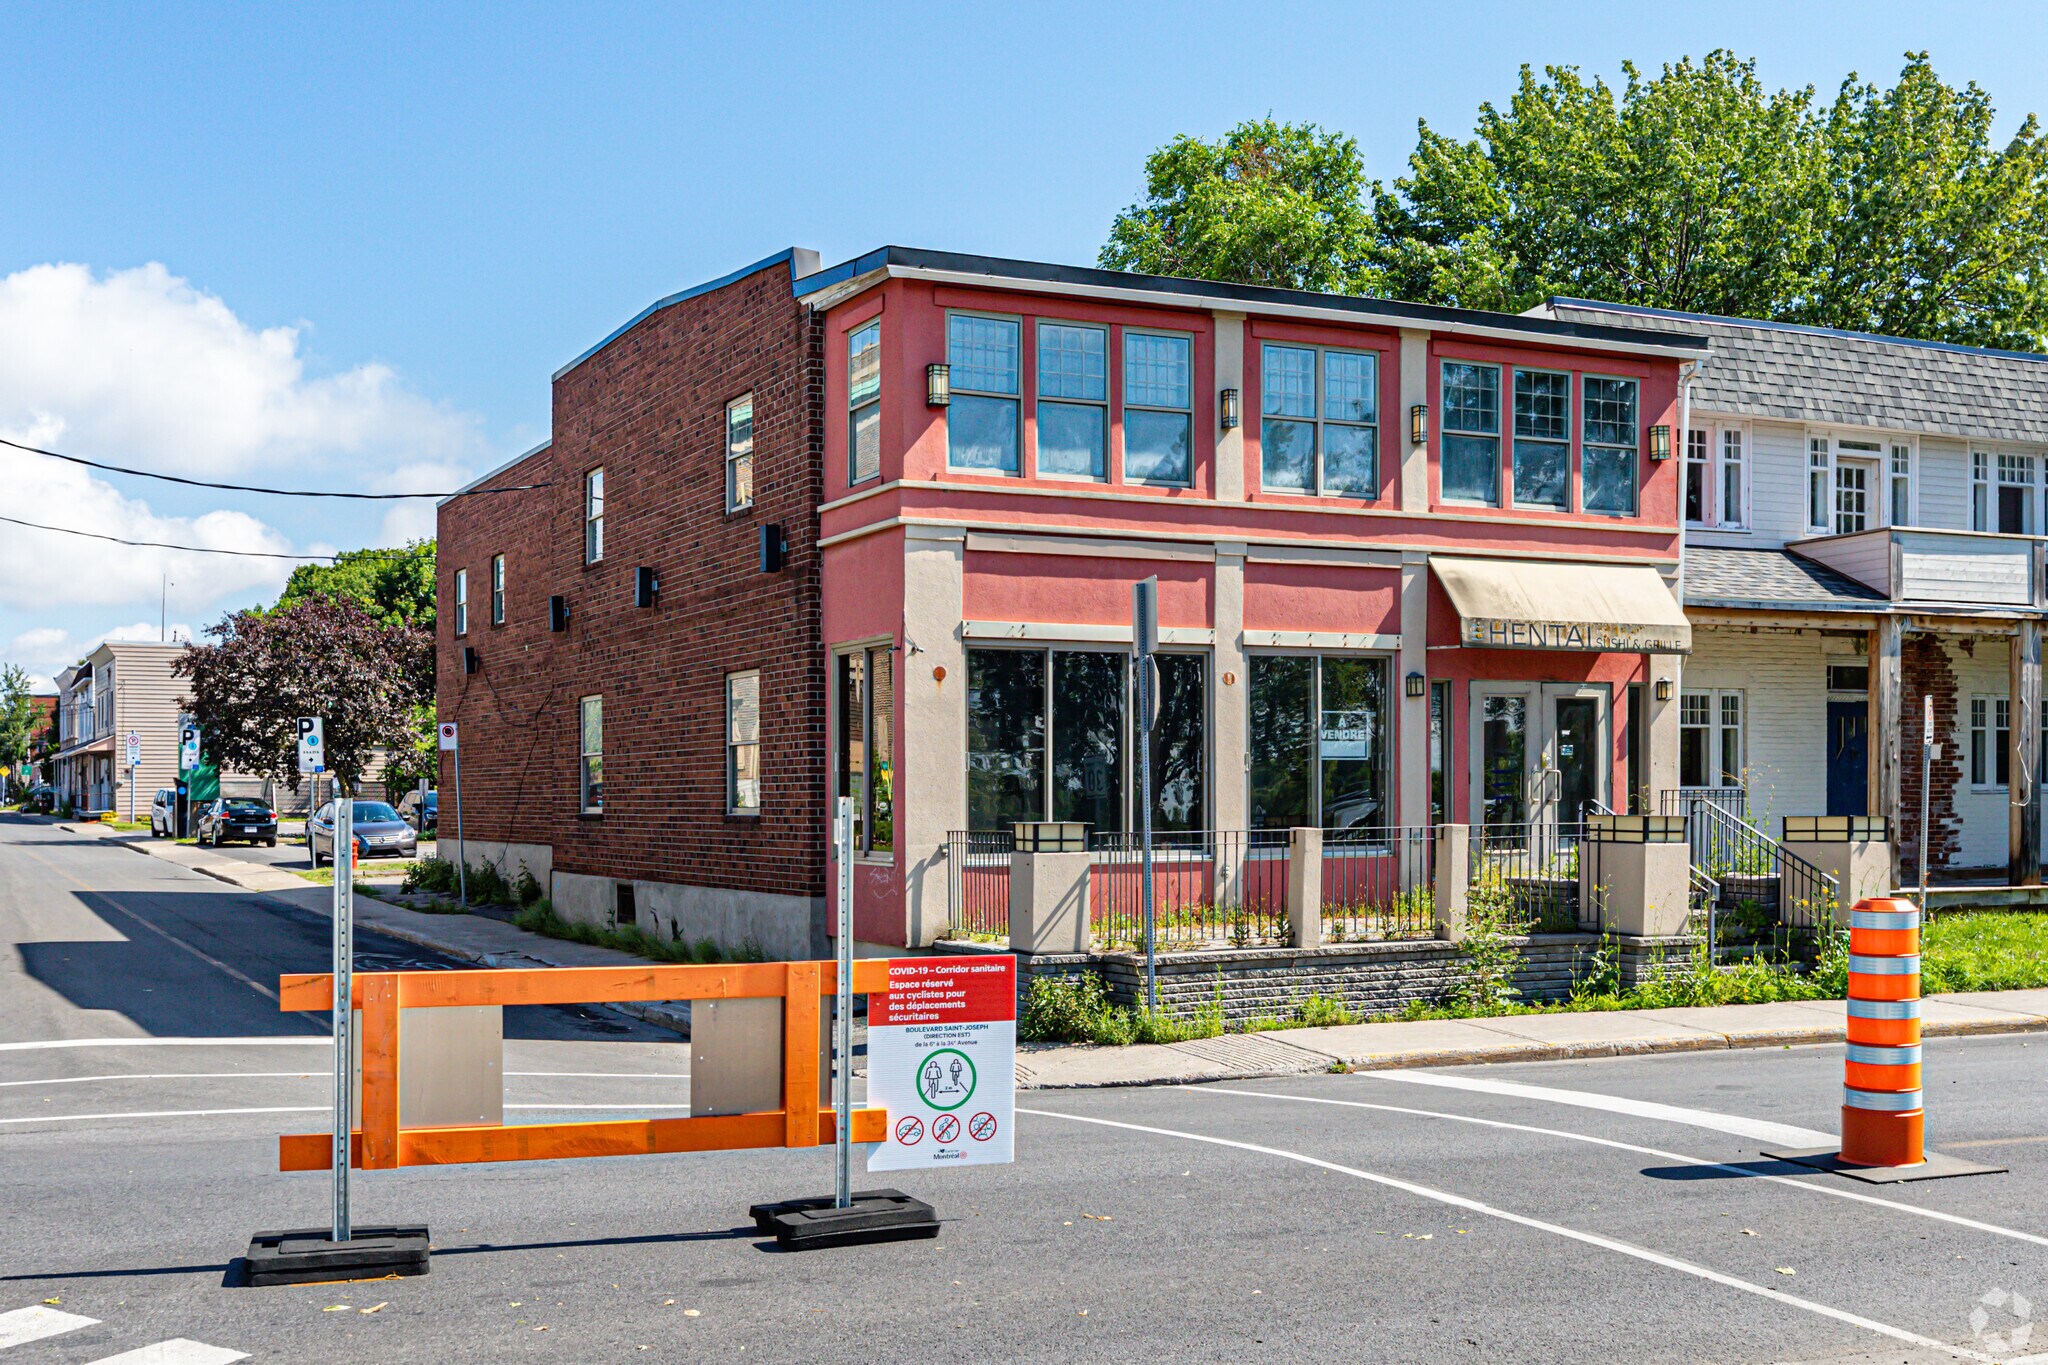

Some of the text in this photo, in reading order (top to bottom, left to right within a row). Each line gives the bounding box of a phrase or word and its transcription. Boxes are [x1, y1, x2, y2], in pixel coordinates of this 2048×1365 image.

[1489, 622, 1681, 651] HENTAI SUSHI & GRILLE
[298, 718, 315, 740] P
[1321, 729, 1365, 739] VENDRE
[182, 730, 194, 746] P
[889, 966, 928, 975] COVID-19
[935, 965, 969, 974] Corridor
[971, 964, 1006, 973] sanitaire
[889, 978, 954, 990] Espace réservé
[906, 991, 944, 1000] cyclistes
[946, 991, 966, 999] pour
[889, 1000, 966, 1011] des déplacements
[889, 1012, 939, 1021] sécuritaires
[906, 1025, 943, 1033] BOULEVARD
[933, 1152, 960, 1160] Montréal
